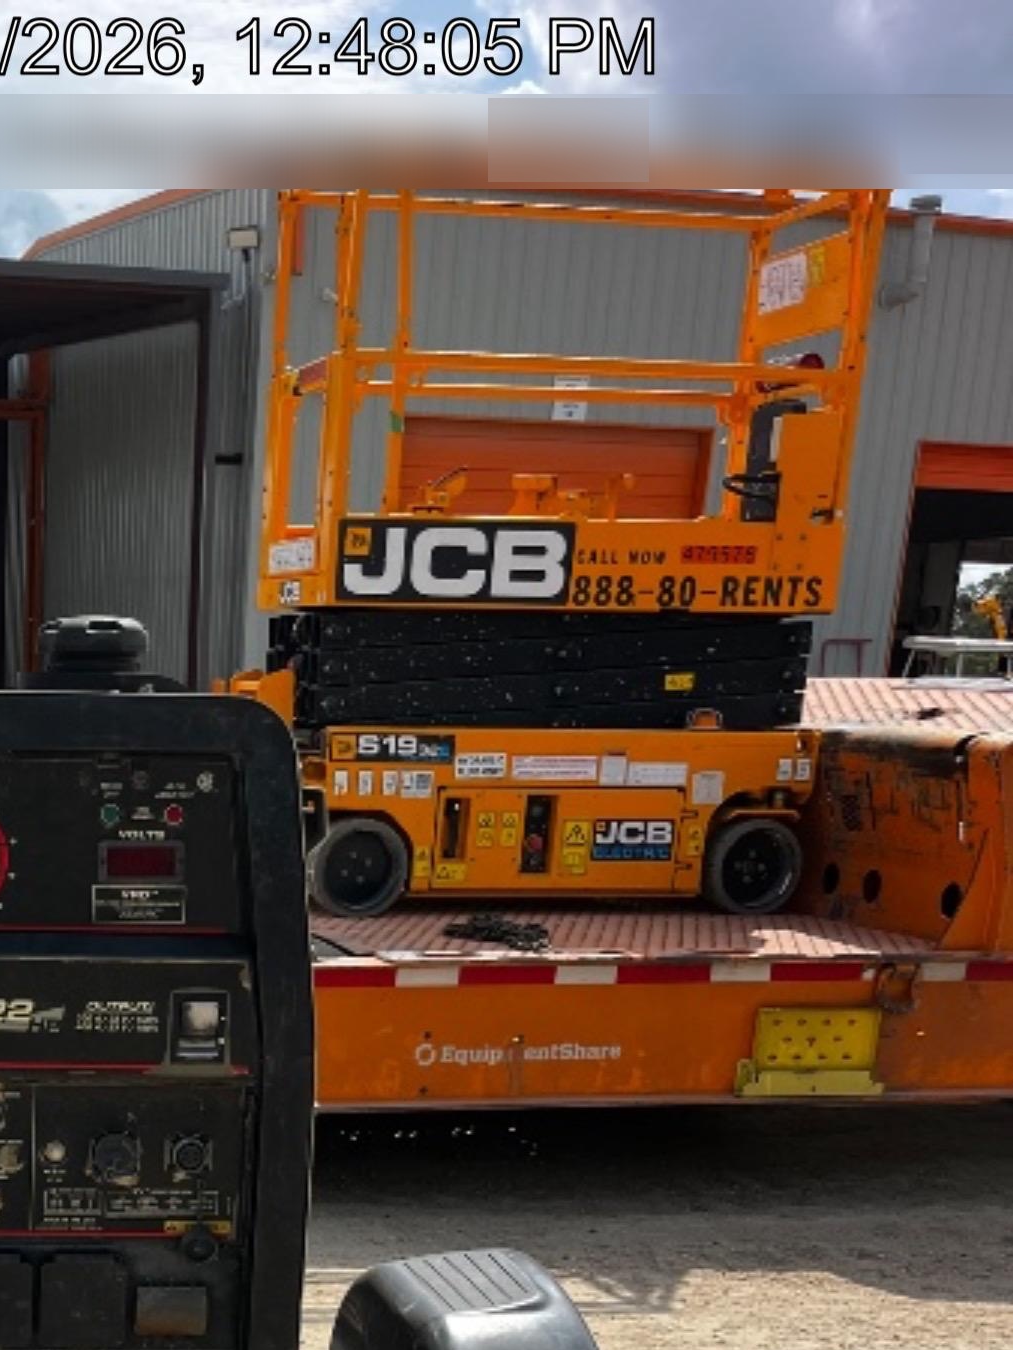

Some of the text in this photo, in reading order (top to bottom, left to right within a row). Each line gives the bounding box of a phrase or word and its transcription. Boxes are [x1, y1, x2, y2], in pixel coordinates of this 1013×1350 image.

[344, 527, 567, 597] JCB
[577, 550, 618, 565] CALL
[629, 550, 666, 565] NOW
[572, 575, 823, 607] 888-80-RENTS
[596, 821, 672, 844] JCB
[440, 1043, 621, 1065] EquipentShare
